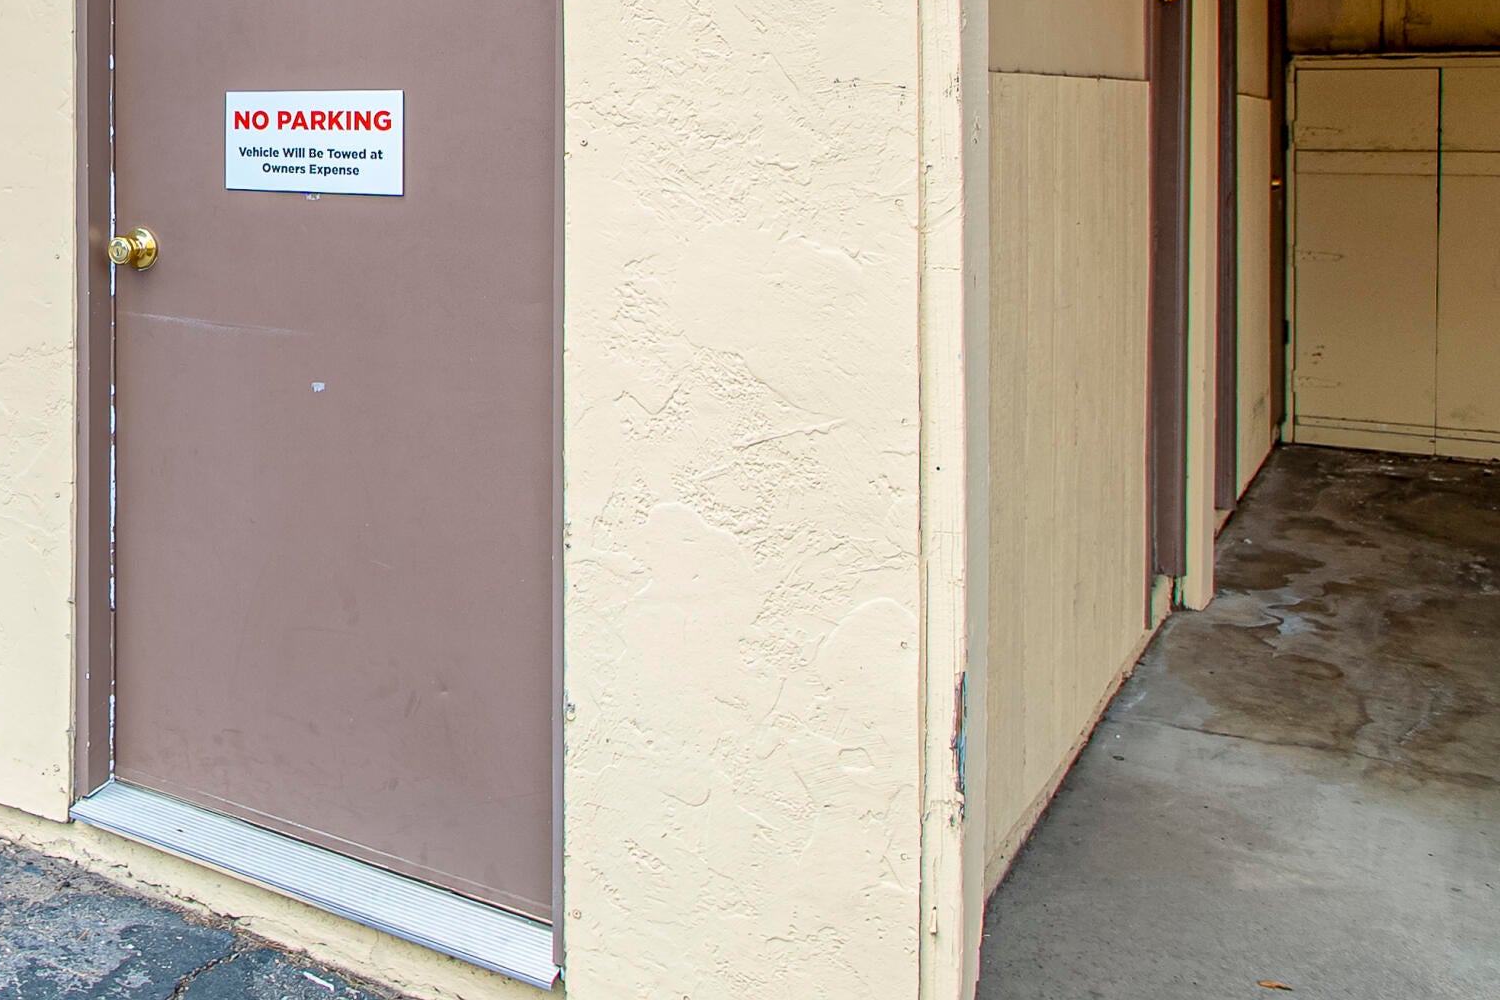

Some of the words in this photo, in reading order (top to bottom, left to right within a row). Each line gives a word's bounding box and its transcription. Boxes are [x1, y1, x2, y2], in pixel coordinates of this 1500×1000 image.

[234, 110, 269, 131] NO
[277, 110, 392, 132] PARKING
[238, 146, 280, 158] Vehicle
[282, 147, 306, 159] Will
[308, 147, 324, 159] Be
[327, 148, 367, 160] Towed
[370, 149, 384, 160] at
[262, 162, 306, 174] Owners
[309, 163, 360, 177] Expense
